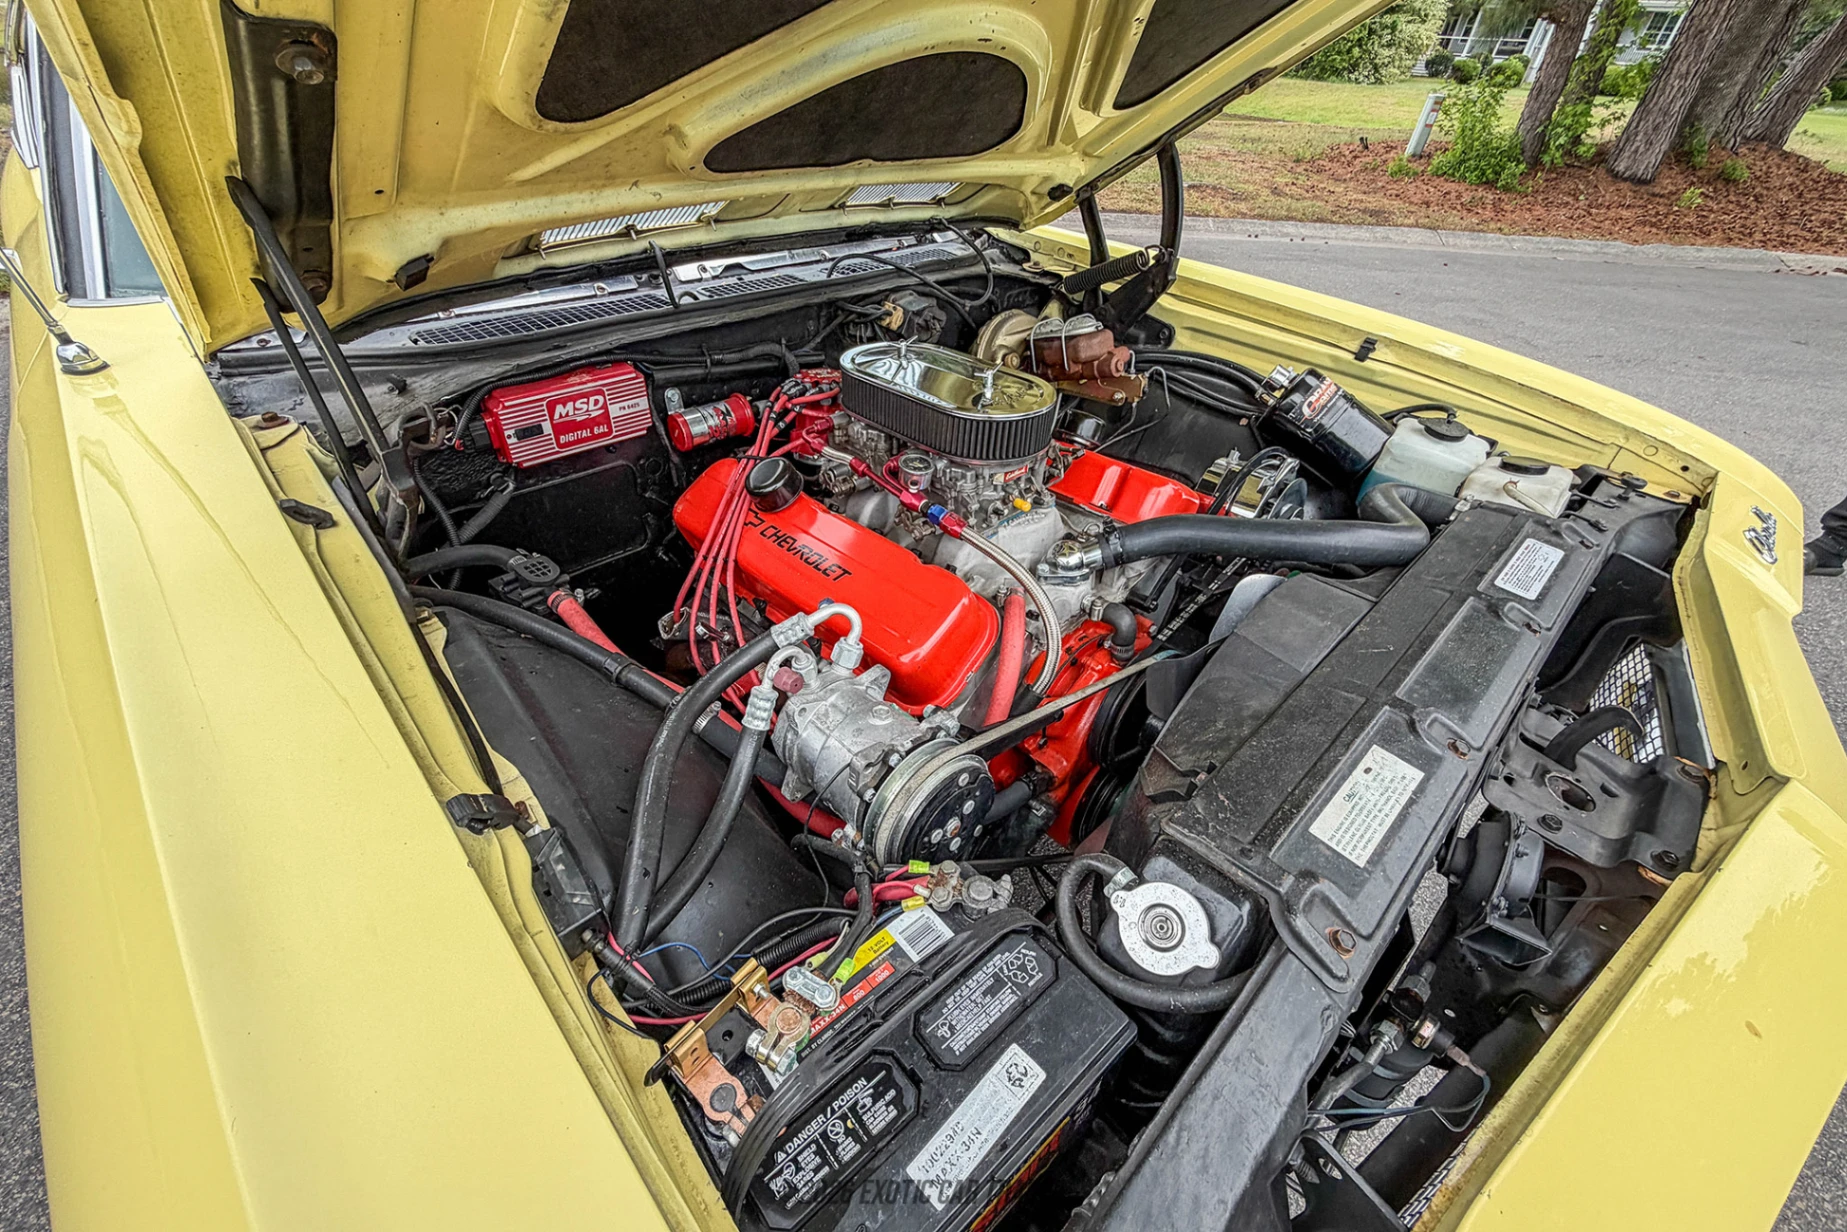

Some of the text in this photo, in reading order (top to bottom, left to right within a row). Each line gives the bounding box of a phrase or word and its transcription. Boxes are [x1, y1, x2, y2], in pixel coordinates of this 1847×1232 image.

[554, 395, 604, 420] MSD
[560, 424, 608, 444] DIGITAL 6AL
[760, 525, 852, 581] CHEVROLET
[874, 969, 890, 983] 1000
[785, 1112, 826, 1154] DANGER
[832, 1077, 867, 1111] POISON
